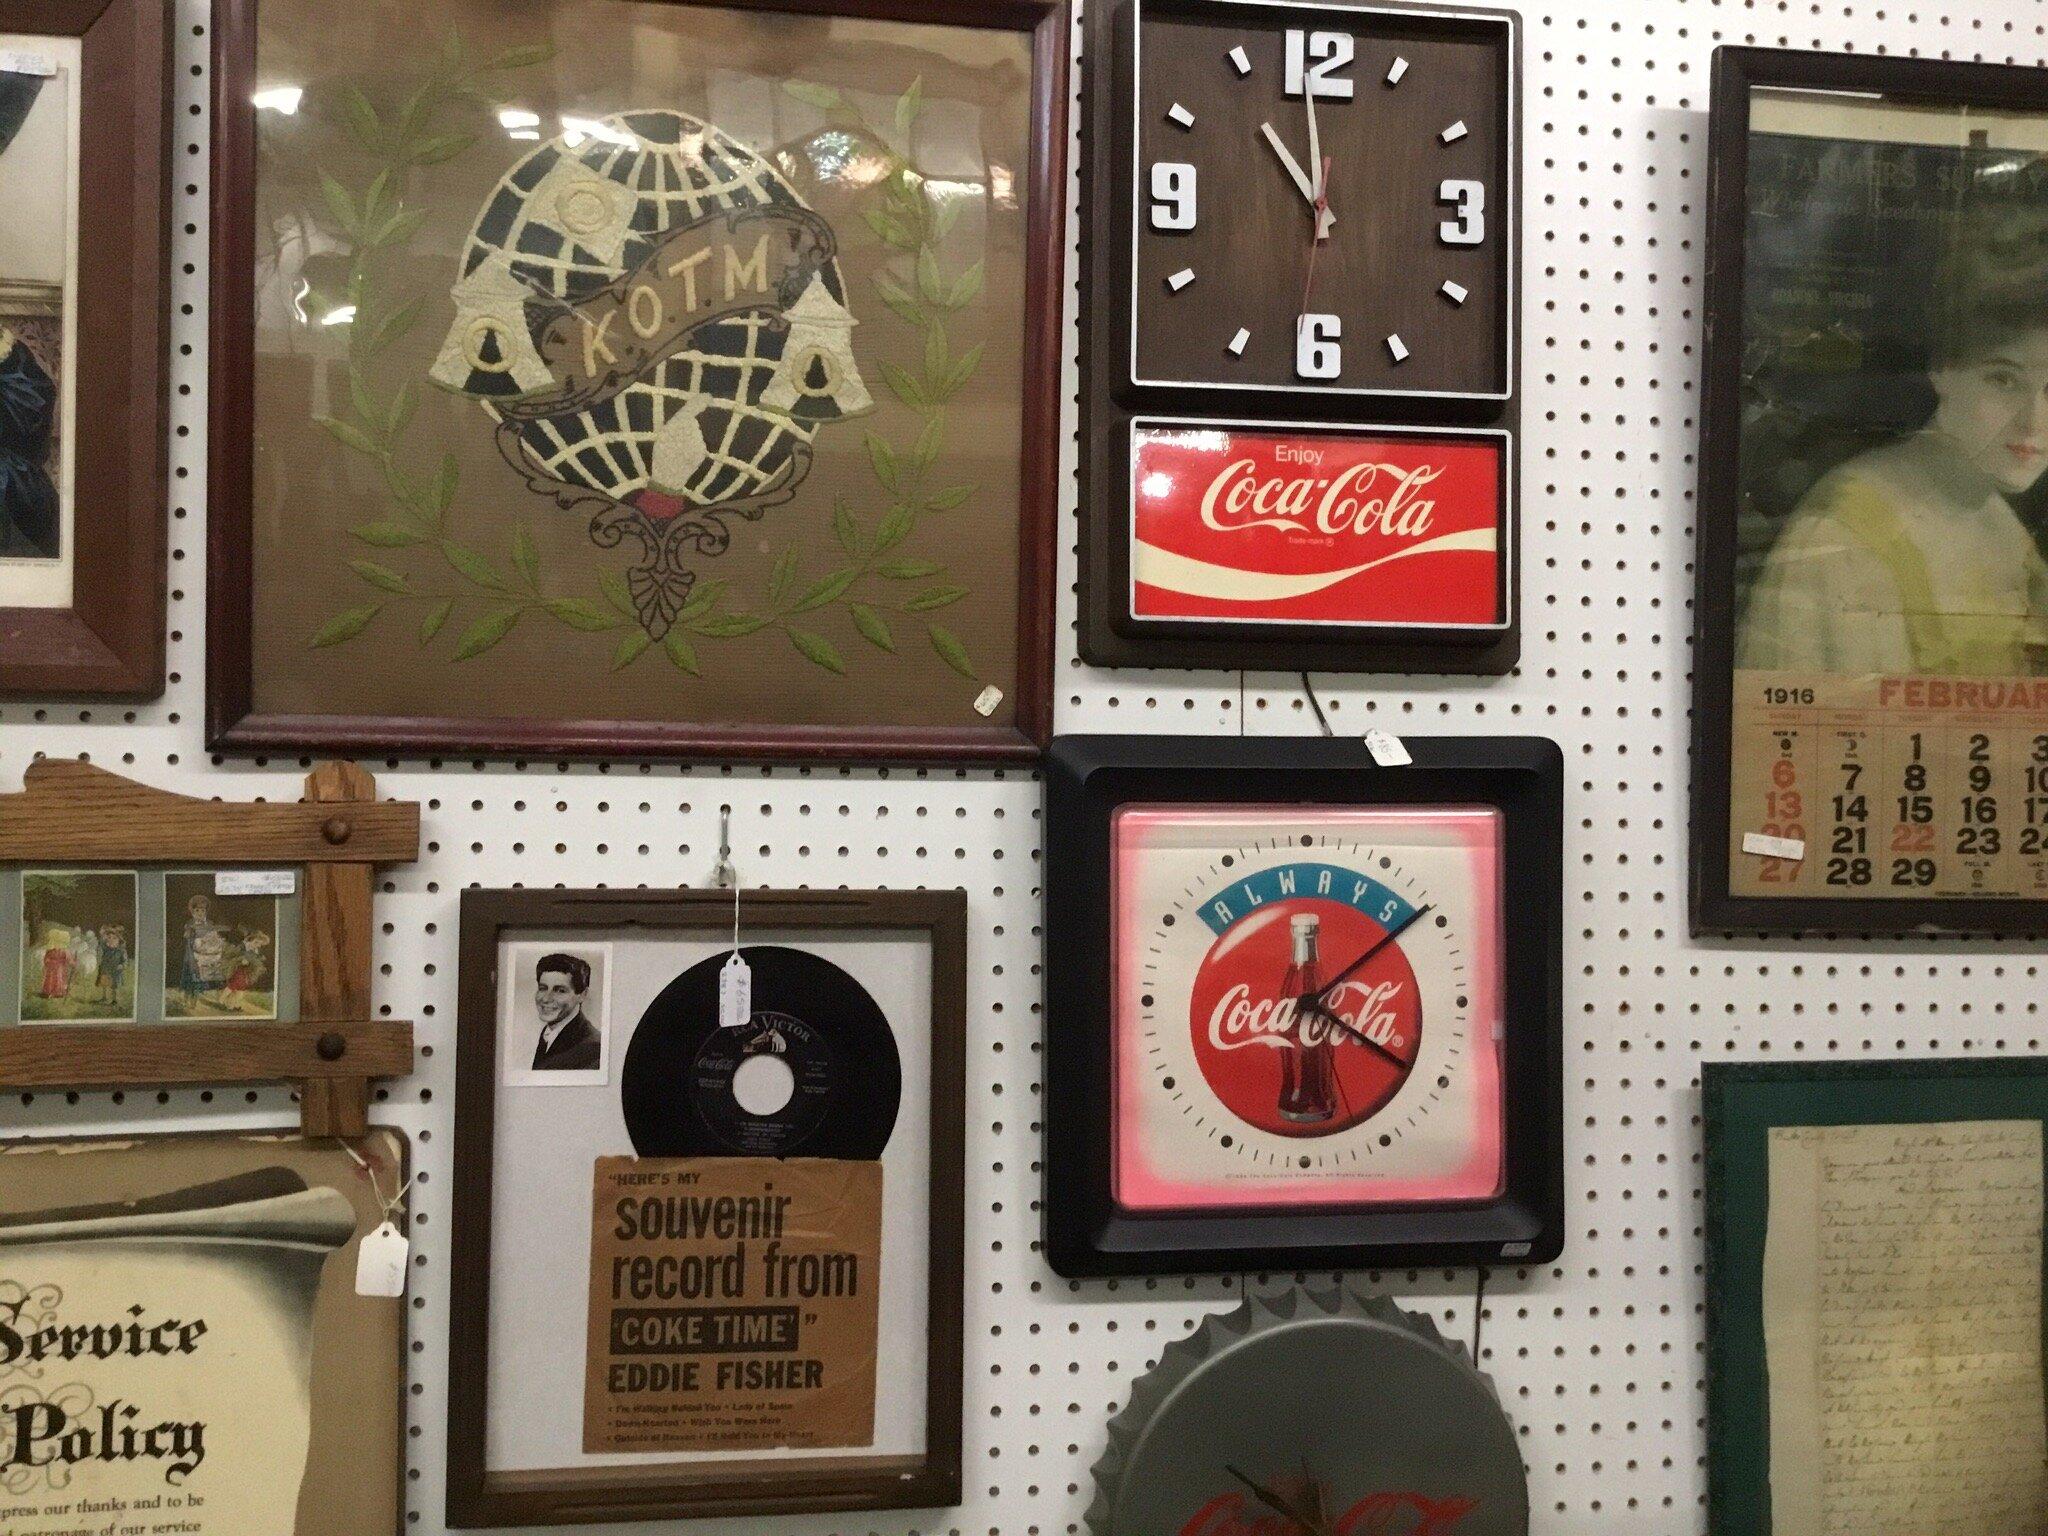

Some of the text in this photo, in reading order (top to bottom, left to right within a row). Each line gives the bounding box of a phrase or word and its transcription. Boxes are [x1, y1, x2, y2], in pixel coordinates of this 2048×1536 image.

[1285, 29, 1354, 97] 12
[1151, 162, 1197, 230] 9
[1440, 179, 1485, 244] 3
[1297, 314, 1341, 378] 6
[1275, 445, 1324, 464] Enjoy
[1200, 459, 1447, 537] Coca-Cola
[1764, 687, 1815, 704] 1916
[1910, 733, 1921, 760] 1
[1969, 734, 1989, 761] 2
[1772, 760, 1796, 789] 6
[1841, 764, 1863, 790] 7
[1904, 764, 1926, 791] 8
[1969, 766, 1991, 792] 9
[1766, 791, 1802, 819] 13
[1832, 795, 1868, 822] 14
[1897, 796, 1933, 823] 15
[1961, 797, 1997, 824] 16
[1832, 826, 1867, 853] 21
[1891, 824, 1935, 851] 22
[1957, 828, 2000, 855] 23
[1826, 858, 1872, 885] 28
[1891, 859, 1936, 886] 29
[1214, 869, 1398, 924] ALWAYS
[1208, 983, 1403, 1051] CocaCola
[677, 1173, 701, 1185] MY
[614, 1183, 792, 1241] souvenir
[612, 1241, 858, 1300] record from
[0, 1296, 208, 1364] Service
[608, 1360, 824, 1393] EDDIE FISHER
[0, 1399, 207, 1486] Policy
[44, 1503, 71, 1515] our
[77, 1497, 127, 1513] thanks
[133, 1494, 161, 1509] and
[167, 1497, 182, 1508] to
[188, 1493, 205, 1506] be
[100, 1522, 116, 1536] of
[120, 1524, 146, 1536] our
[152, 1520, 201, 1534] service
